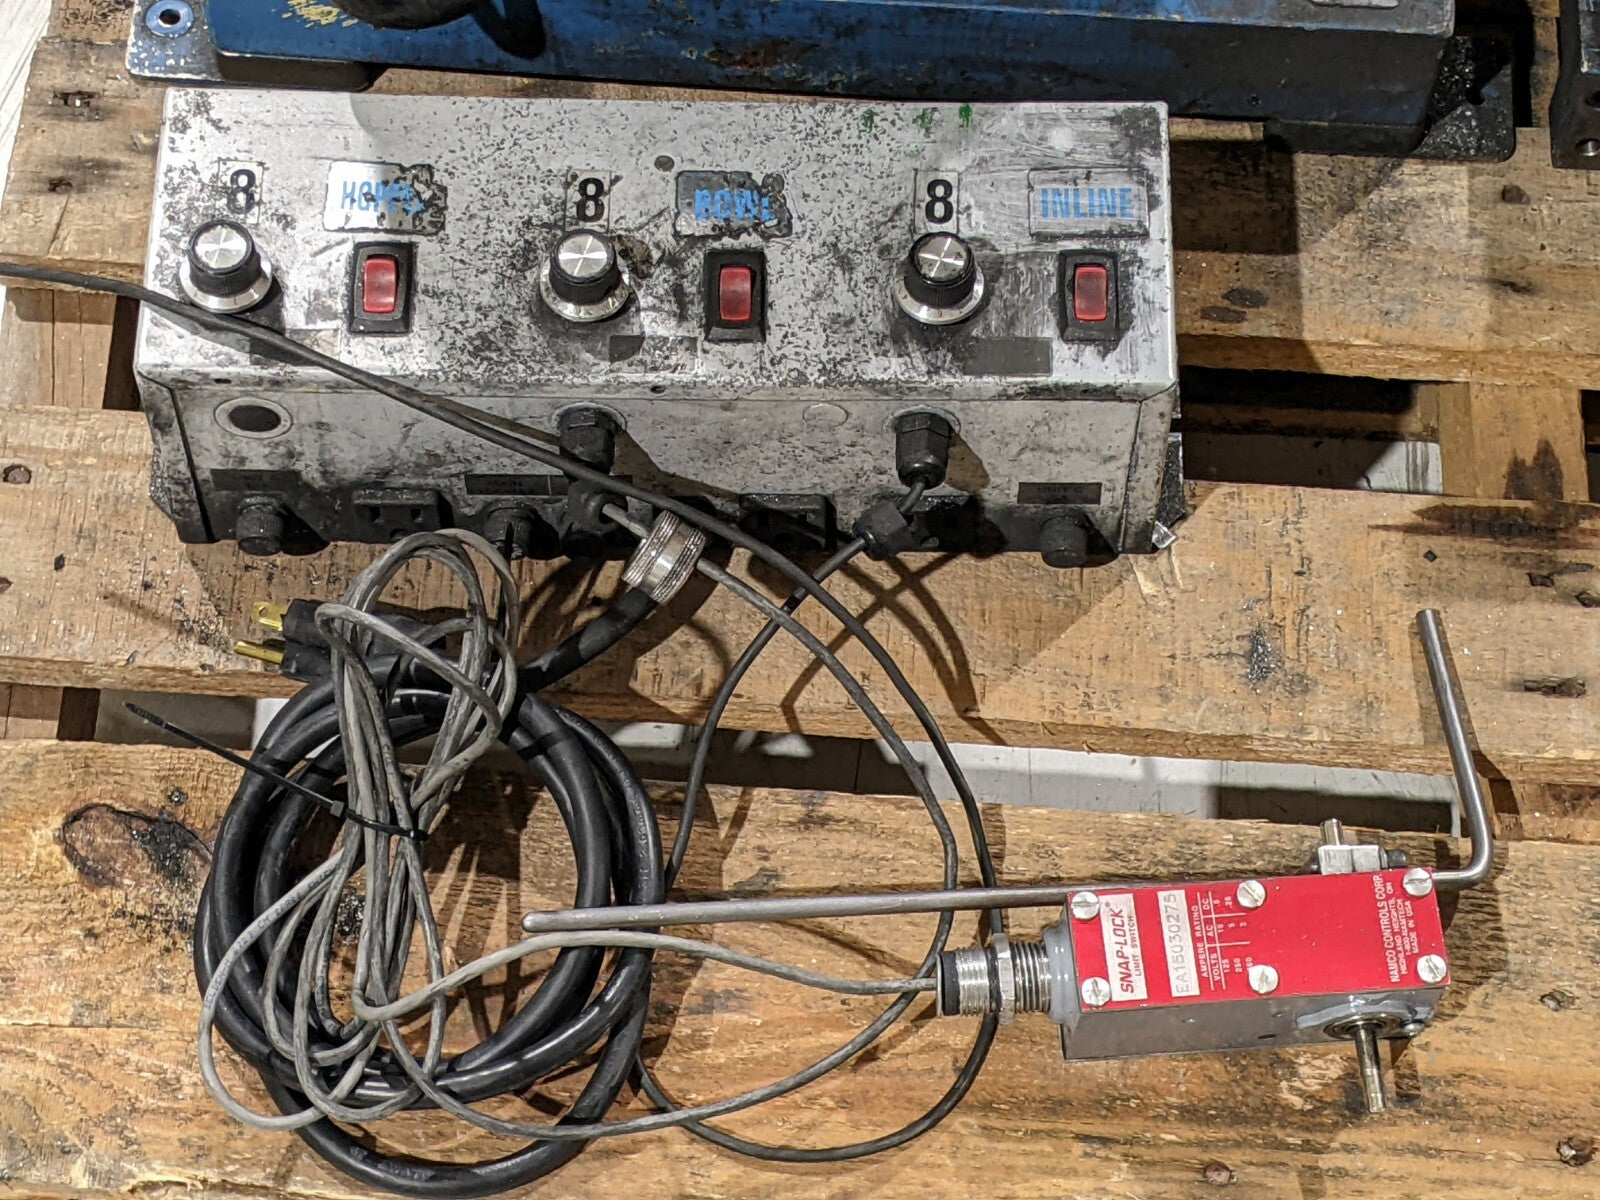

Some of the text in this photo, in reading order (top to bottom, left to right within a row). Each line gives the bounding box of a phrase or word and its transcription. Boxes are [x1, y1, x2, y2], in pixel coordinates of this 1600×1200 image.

[227, 168, 256, 214] 8
[576, 177, 605, 223] 8
[925, 178, 954, 224] 8
[1040, 187, 1134, 219] INLINE
[1372, 873, 1401, 983] NAMCO CONTROLS CORP.
[1404, 900, 1414, 917] USA
[1127, 915, 1142, 977] LIMIT SWITCH
[1163, 893, 1190, 994] EA15030275
[1191, 905, 1209, 978] AMPERE RATING
[1201, 898, 1221, 981] VOLTS AC DC
[1409, 931, 1419, 954] MADE
